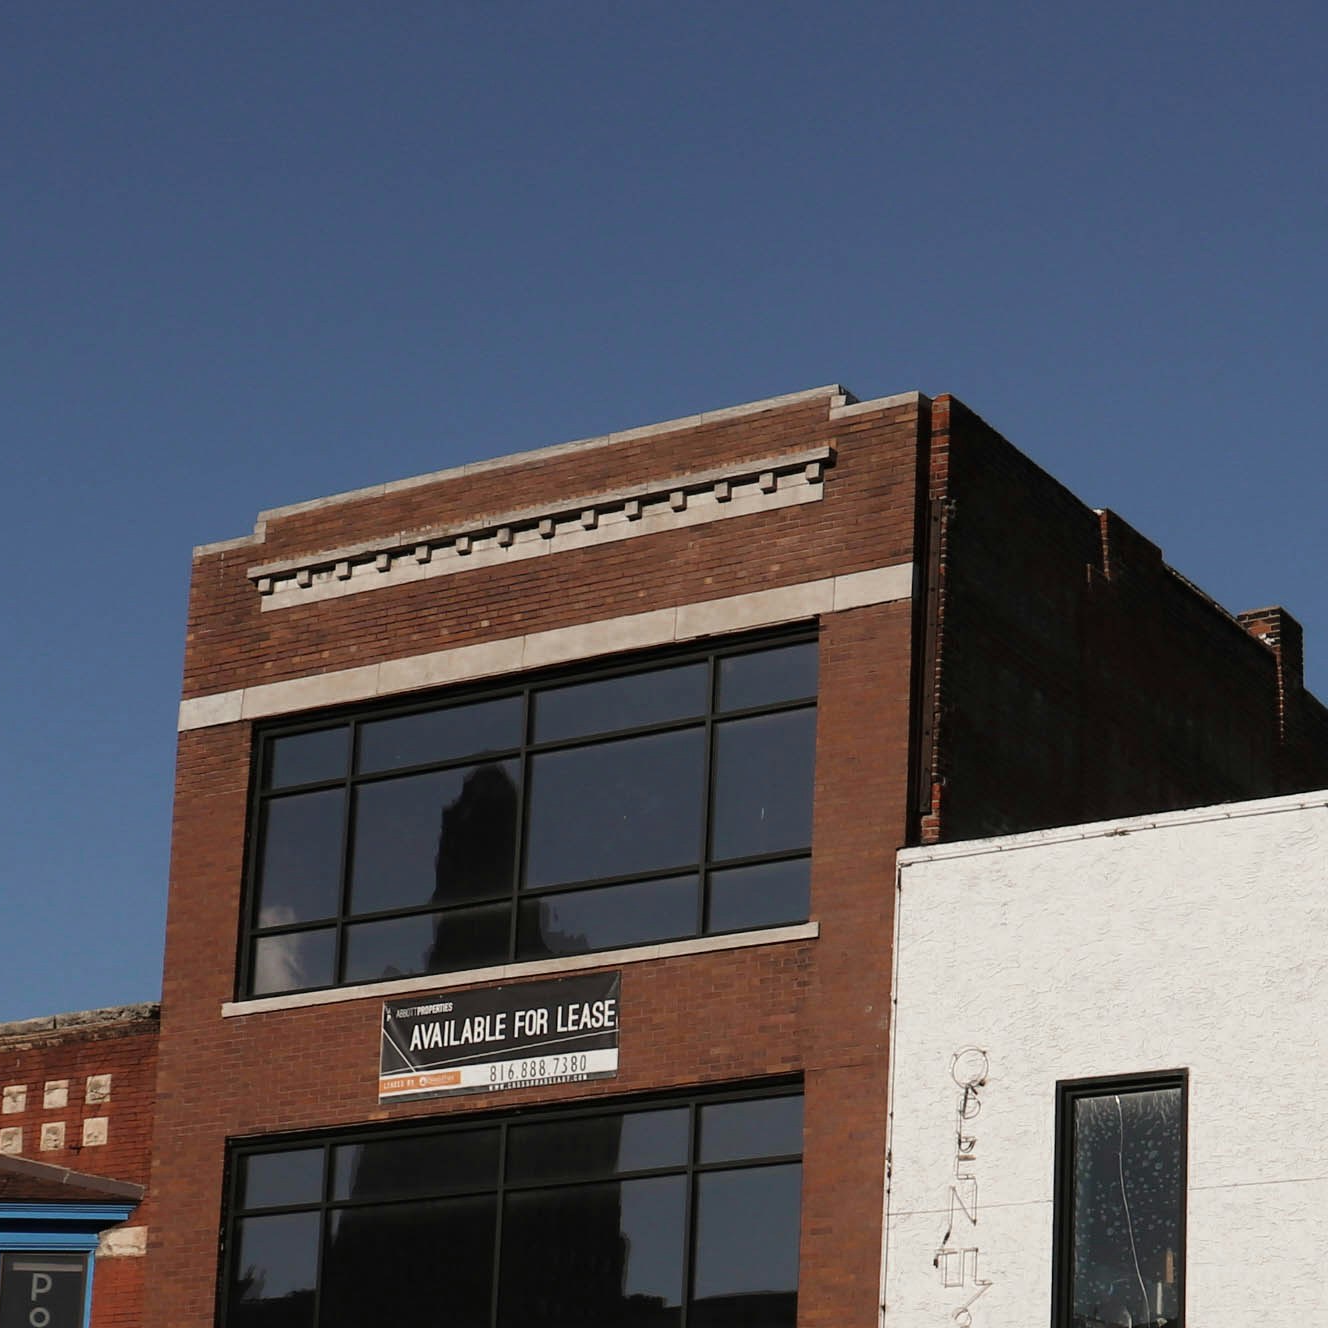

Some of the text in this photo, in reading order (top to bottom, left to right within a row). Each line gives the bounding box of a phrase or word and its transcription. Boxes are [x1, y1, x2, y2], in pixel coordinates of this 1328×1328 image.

[410, 1013, 507, 1051] AVAILABLE
[514, 1008, 548, 1038] FOR
[557, 1000, 617, 1033] LEASE
[489, 1054, 587, 1082] 816.888.7380
